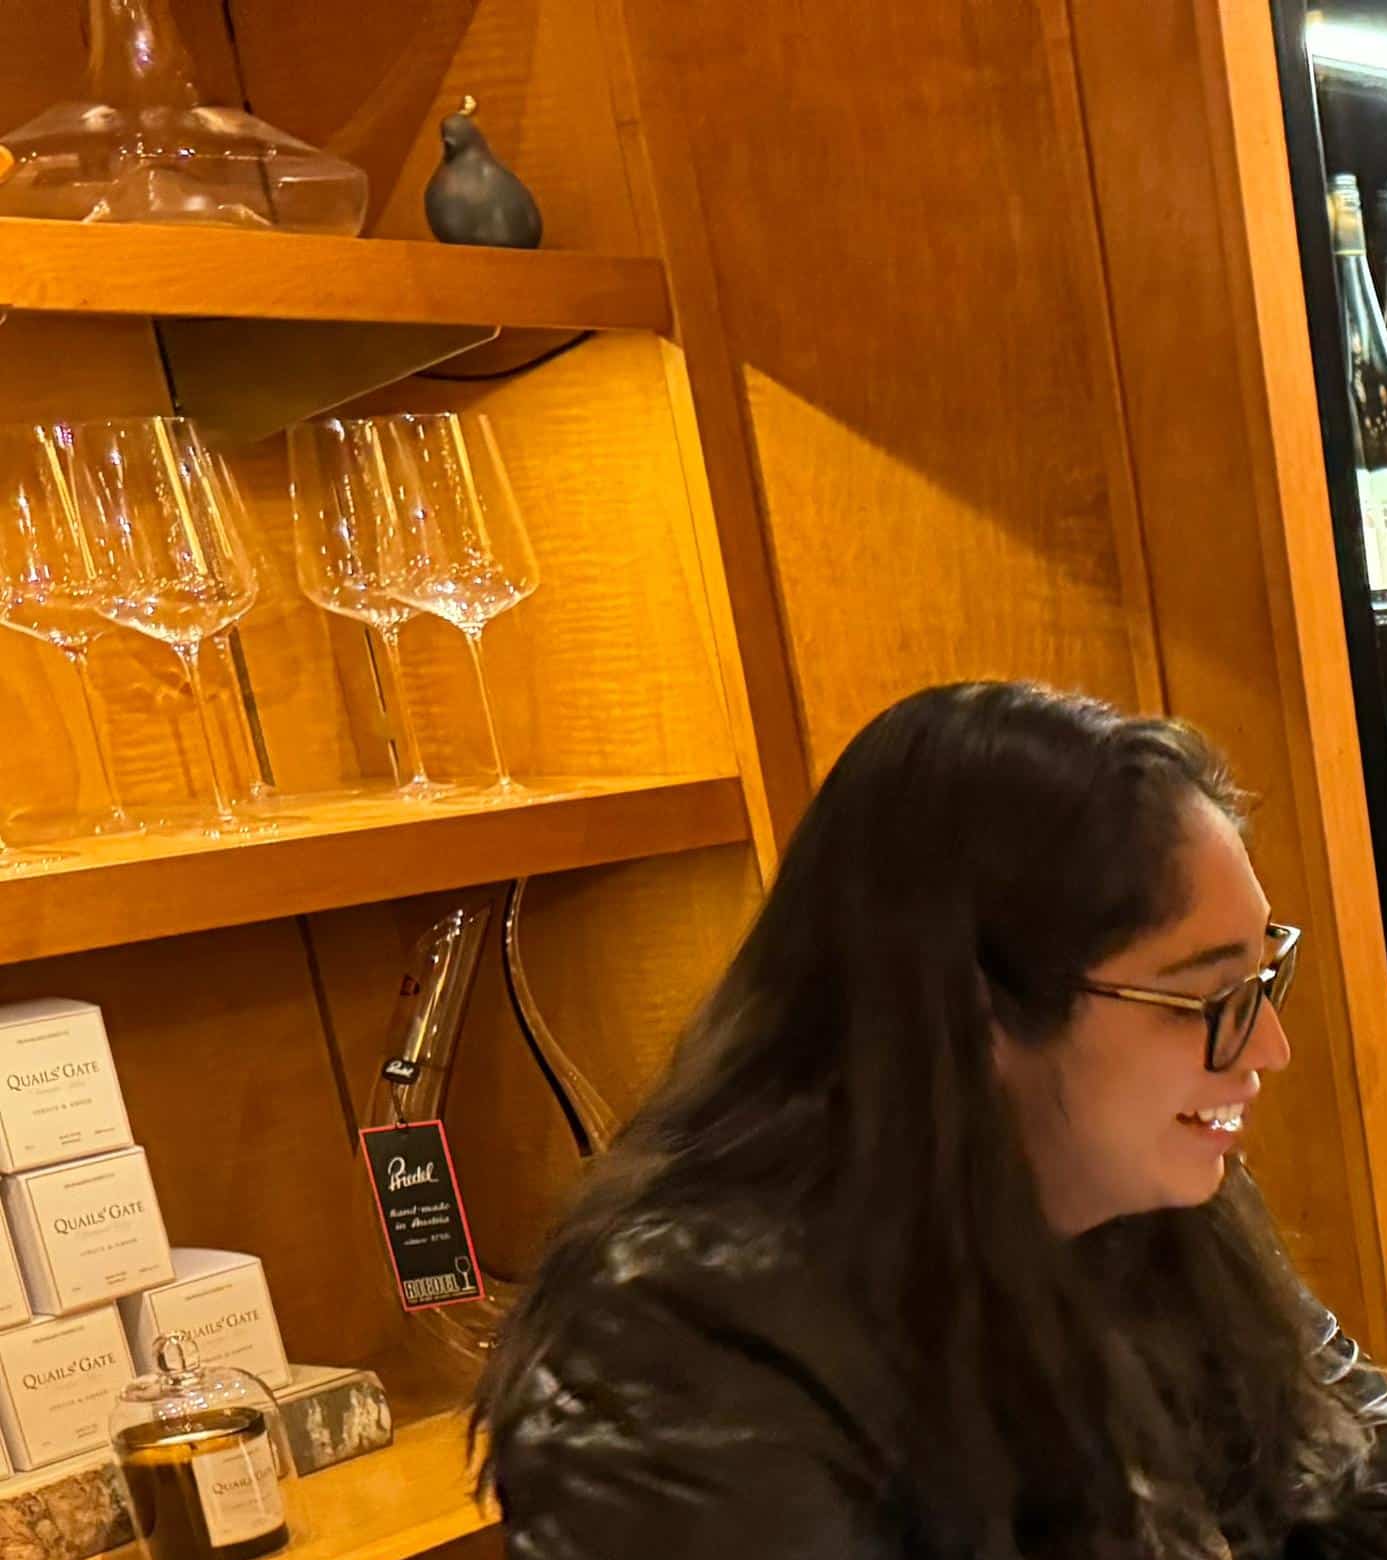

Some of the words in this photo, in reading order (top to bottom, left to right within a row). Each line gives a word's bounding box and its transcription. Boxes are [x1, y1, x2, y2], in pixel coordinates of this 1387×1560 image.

[62, 1061, 100, 1079] GATE
[108, 1201, 144, 1219] GATE
[228, 1309, 260, 1328] GATE
[79, 1354, 117, 1372] GATE
